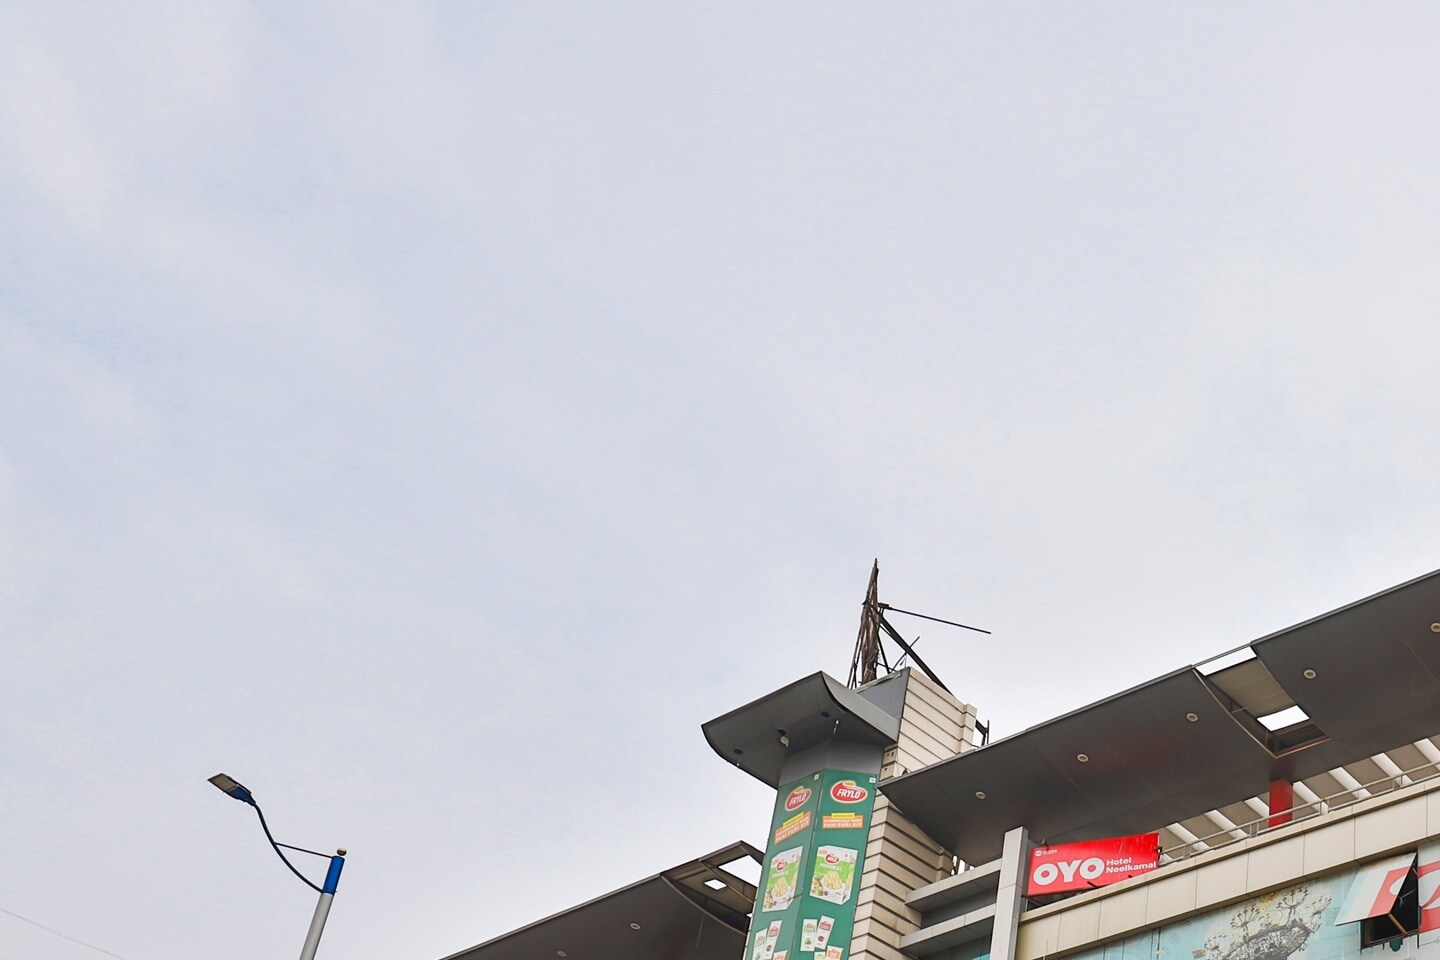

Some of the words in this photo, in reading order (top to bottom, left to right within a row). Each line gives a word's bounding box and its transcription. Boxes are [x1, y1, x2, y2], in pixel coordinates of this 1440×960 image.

[837, 788, 861, 799] FRYLO
[1106, 857, 1132, 867] Hotel
[1106, 861, 1157, 874] Neelkamal
[1033, 857, 1105, 886] OYO
